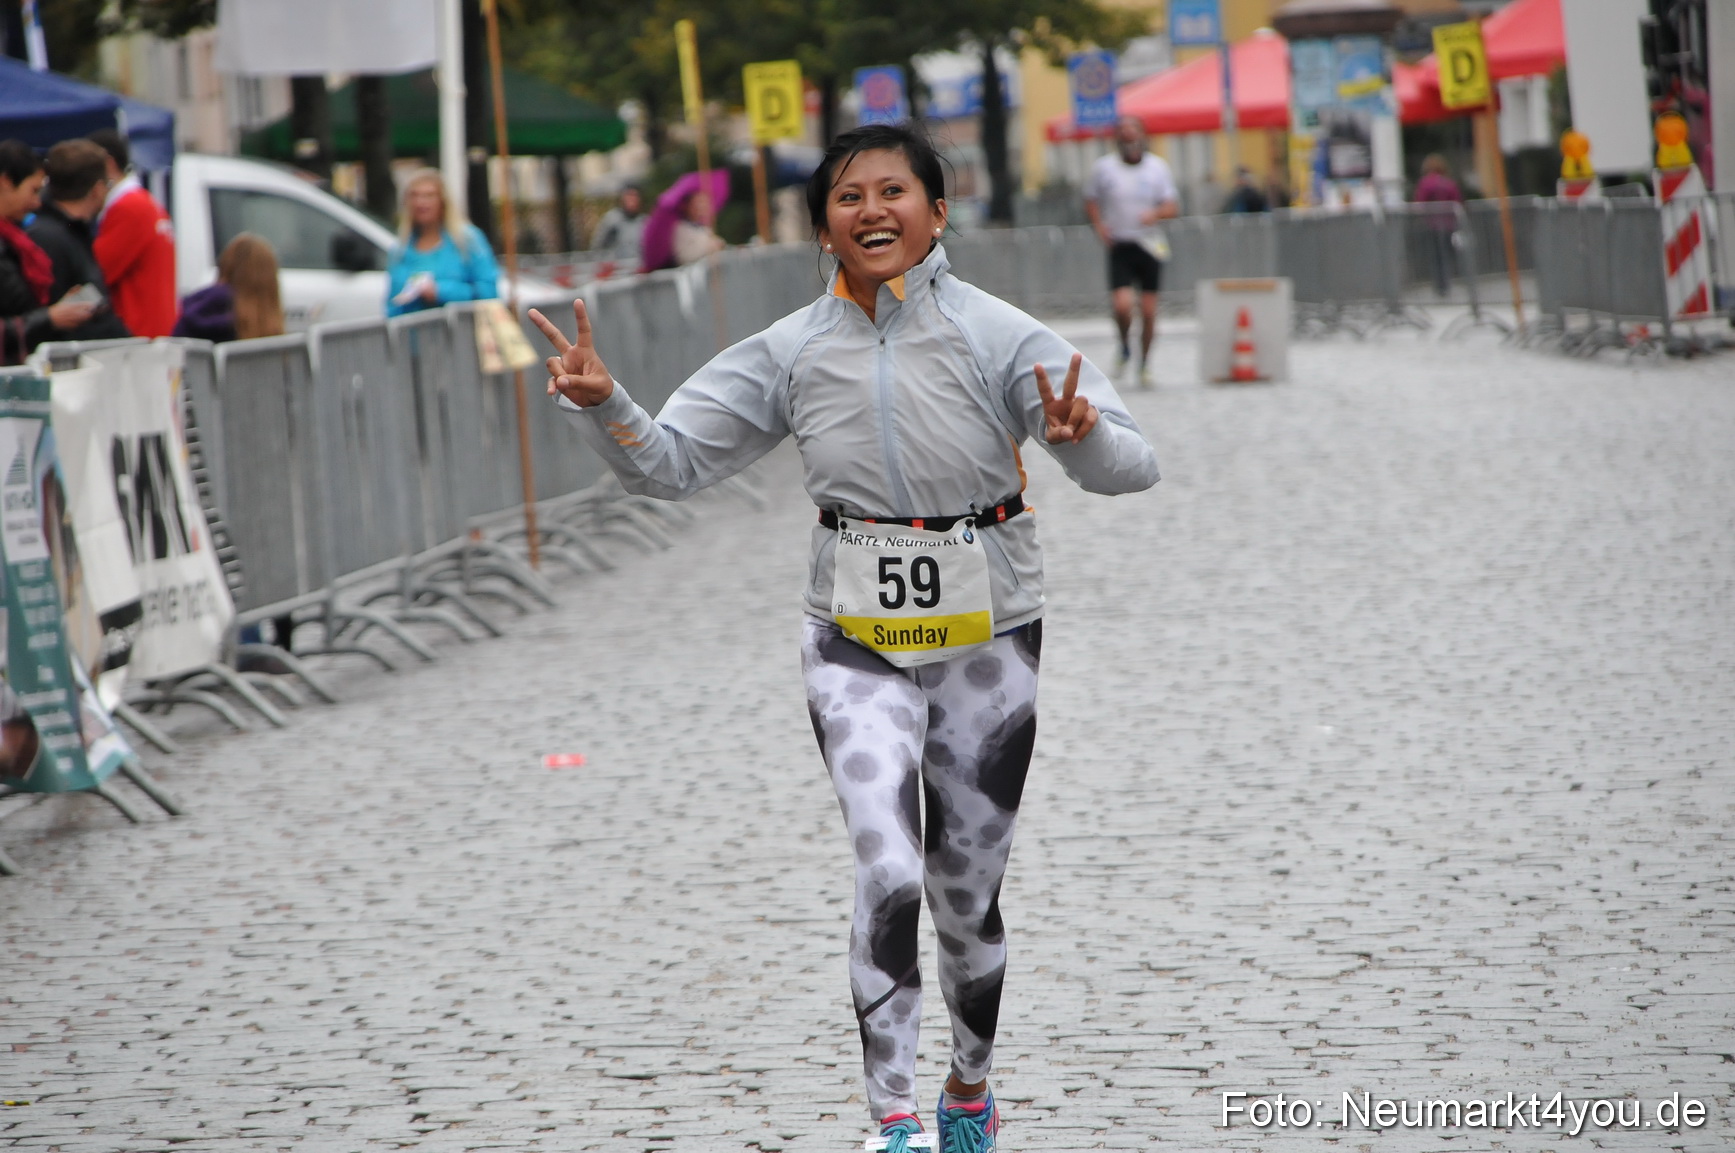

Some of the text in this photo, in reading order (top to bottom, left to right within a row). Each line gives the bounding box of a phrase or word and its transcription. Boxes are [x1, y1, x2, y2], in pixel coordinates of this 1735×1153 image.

[1451, 49, 1475, 86] D
[761, 86, 790, 124] D
[878, 556, 941, 609] 59
[873, 624, 948, 647] Sunday
